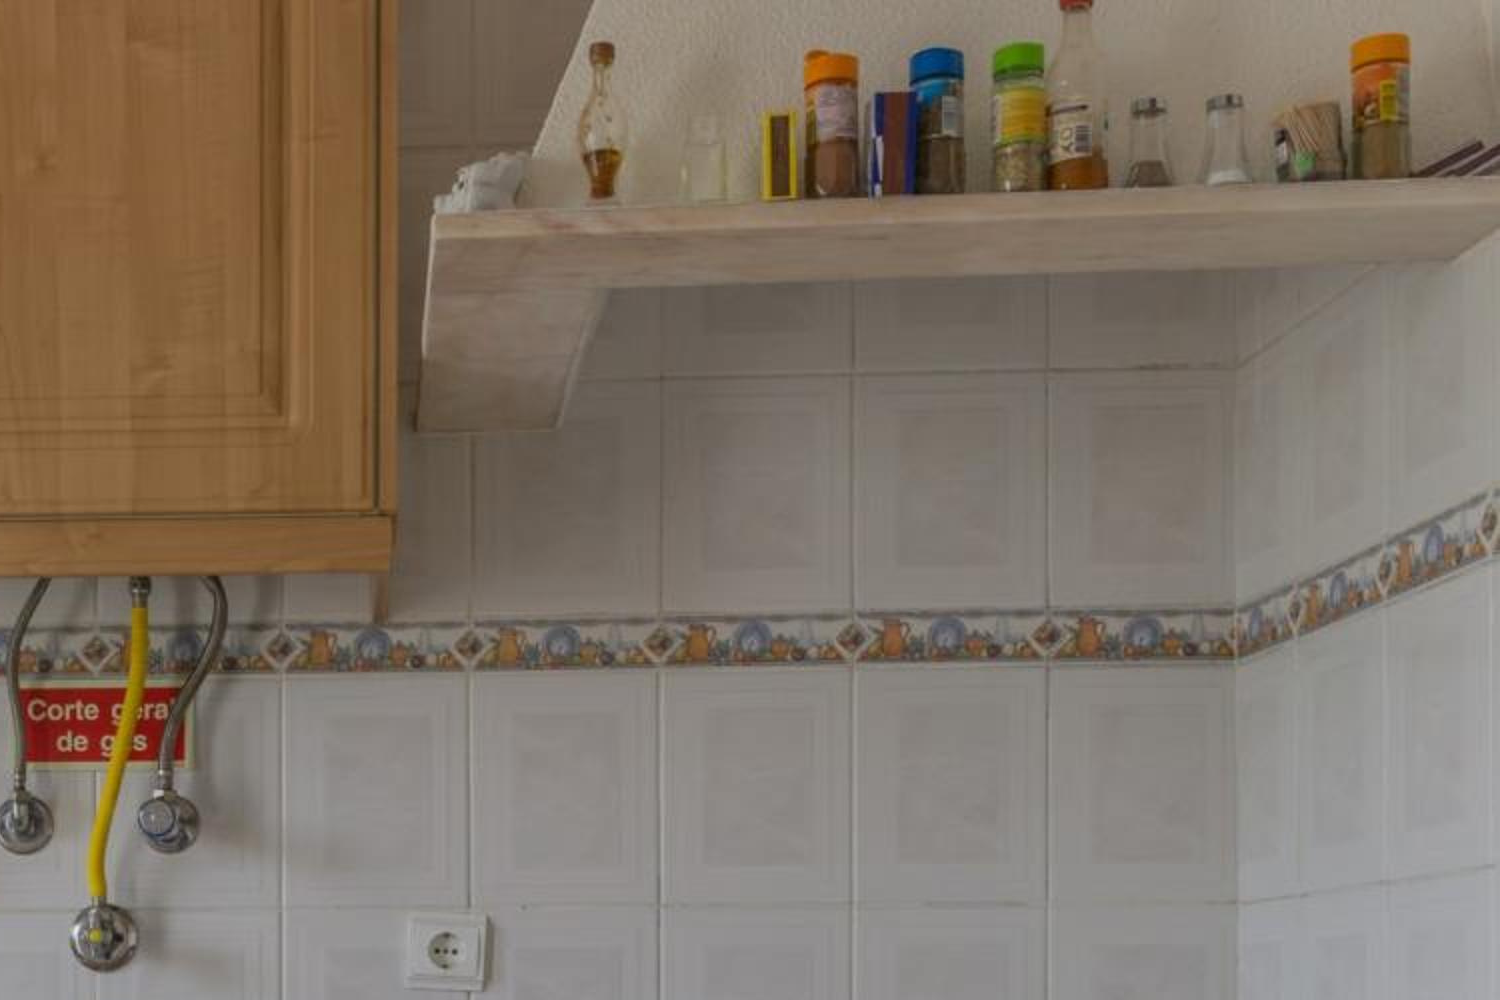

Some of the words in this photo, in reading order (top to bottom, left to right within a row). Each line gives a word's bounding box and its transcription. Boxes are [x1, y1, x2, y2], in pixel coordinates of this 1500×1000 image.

[27, 699, 100, 721] Corte
[56, 730, 89, 752] de
[100, 734, 148, 757] gs
